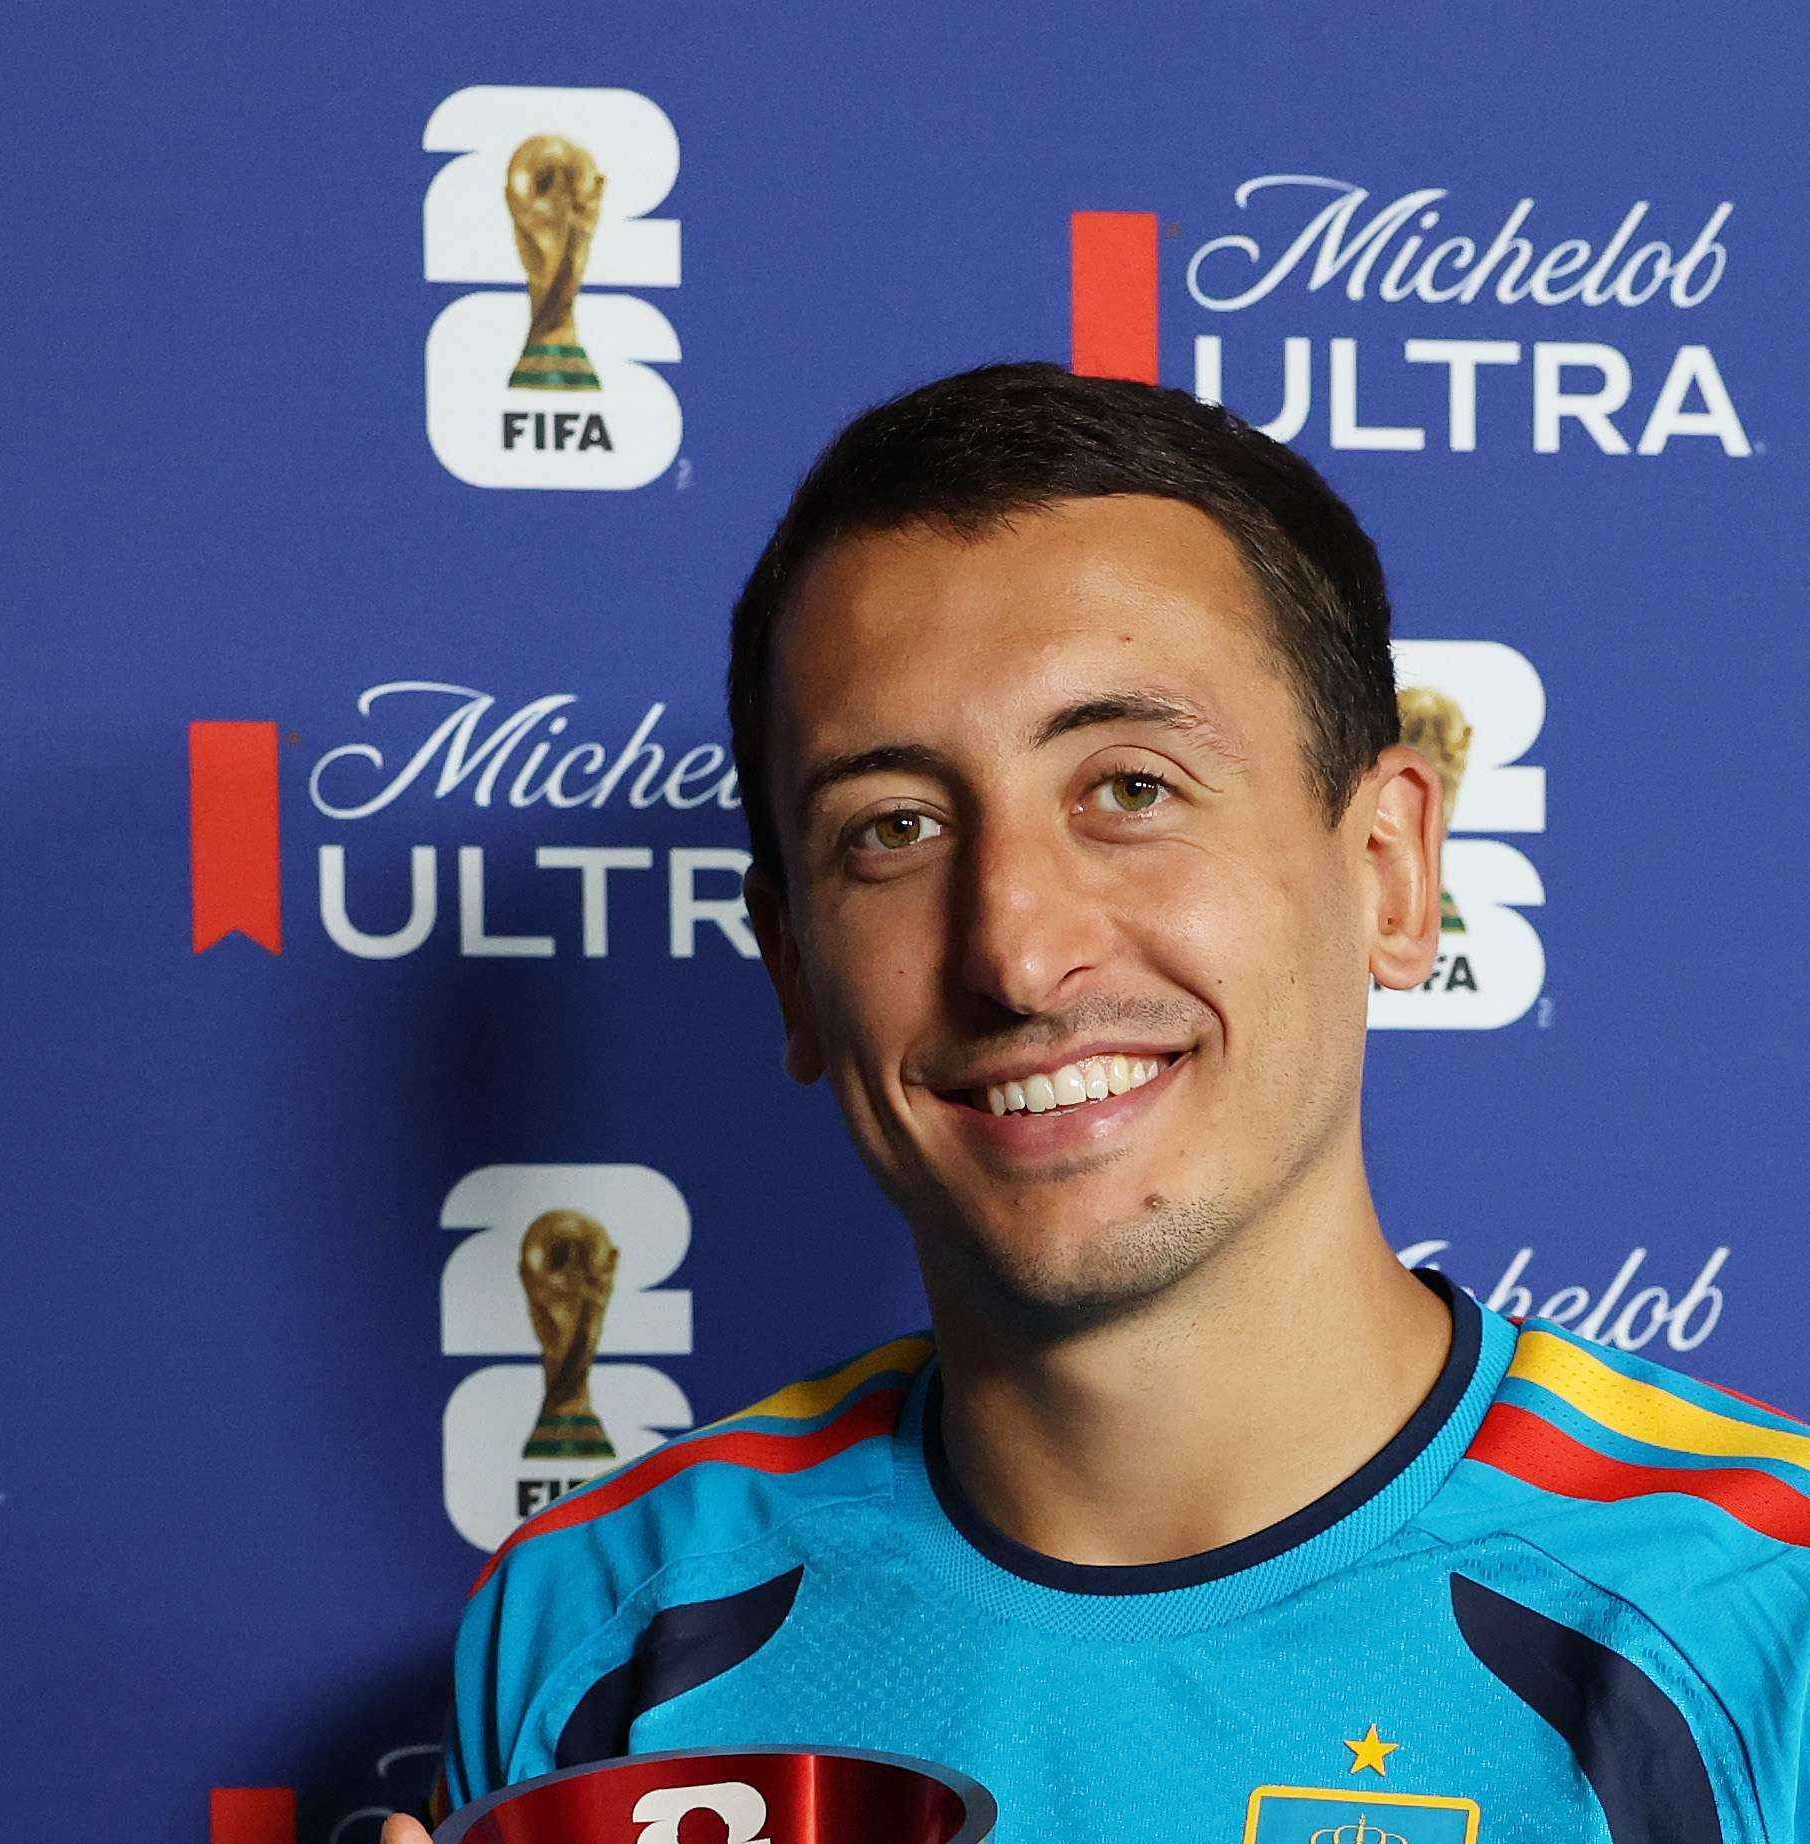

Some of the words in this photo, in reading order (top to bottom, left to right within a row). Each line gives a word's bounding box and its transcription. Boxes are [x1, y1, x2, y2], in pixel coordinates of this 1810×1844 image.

[1185, 173, 1735, 313] Michelob
[502, 411, 614, 453] FIFA
[1191, 333, 1754, 459] ULTRA
[307, 679, 745, 822] Miche
[316, 843, 764, 960] ULTR
